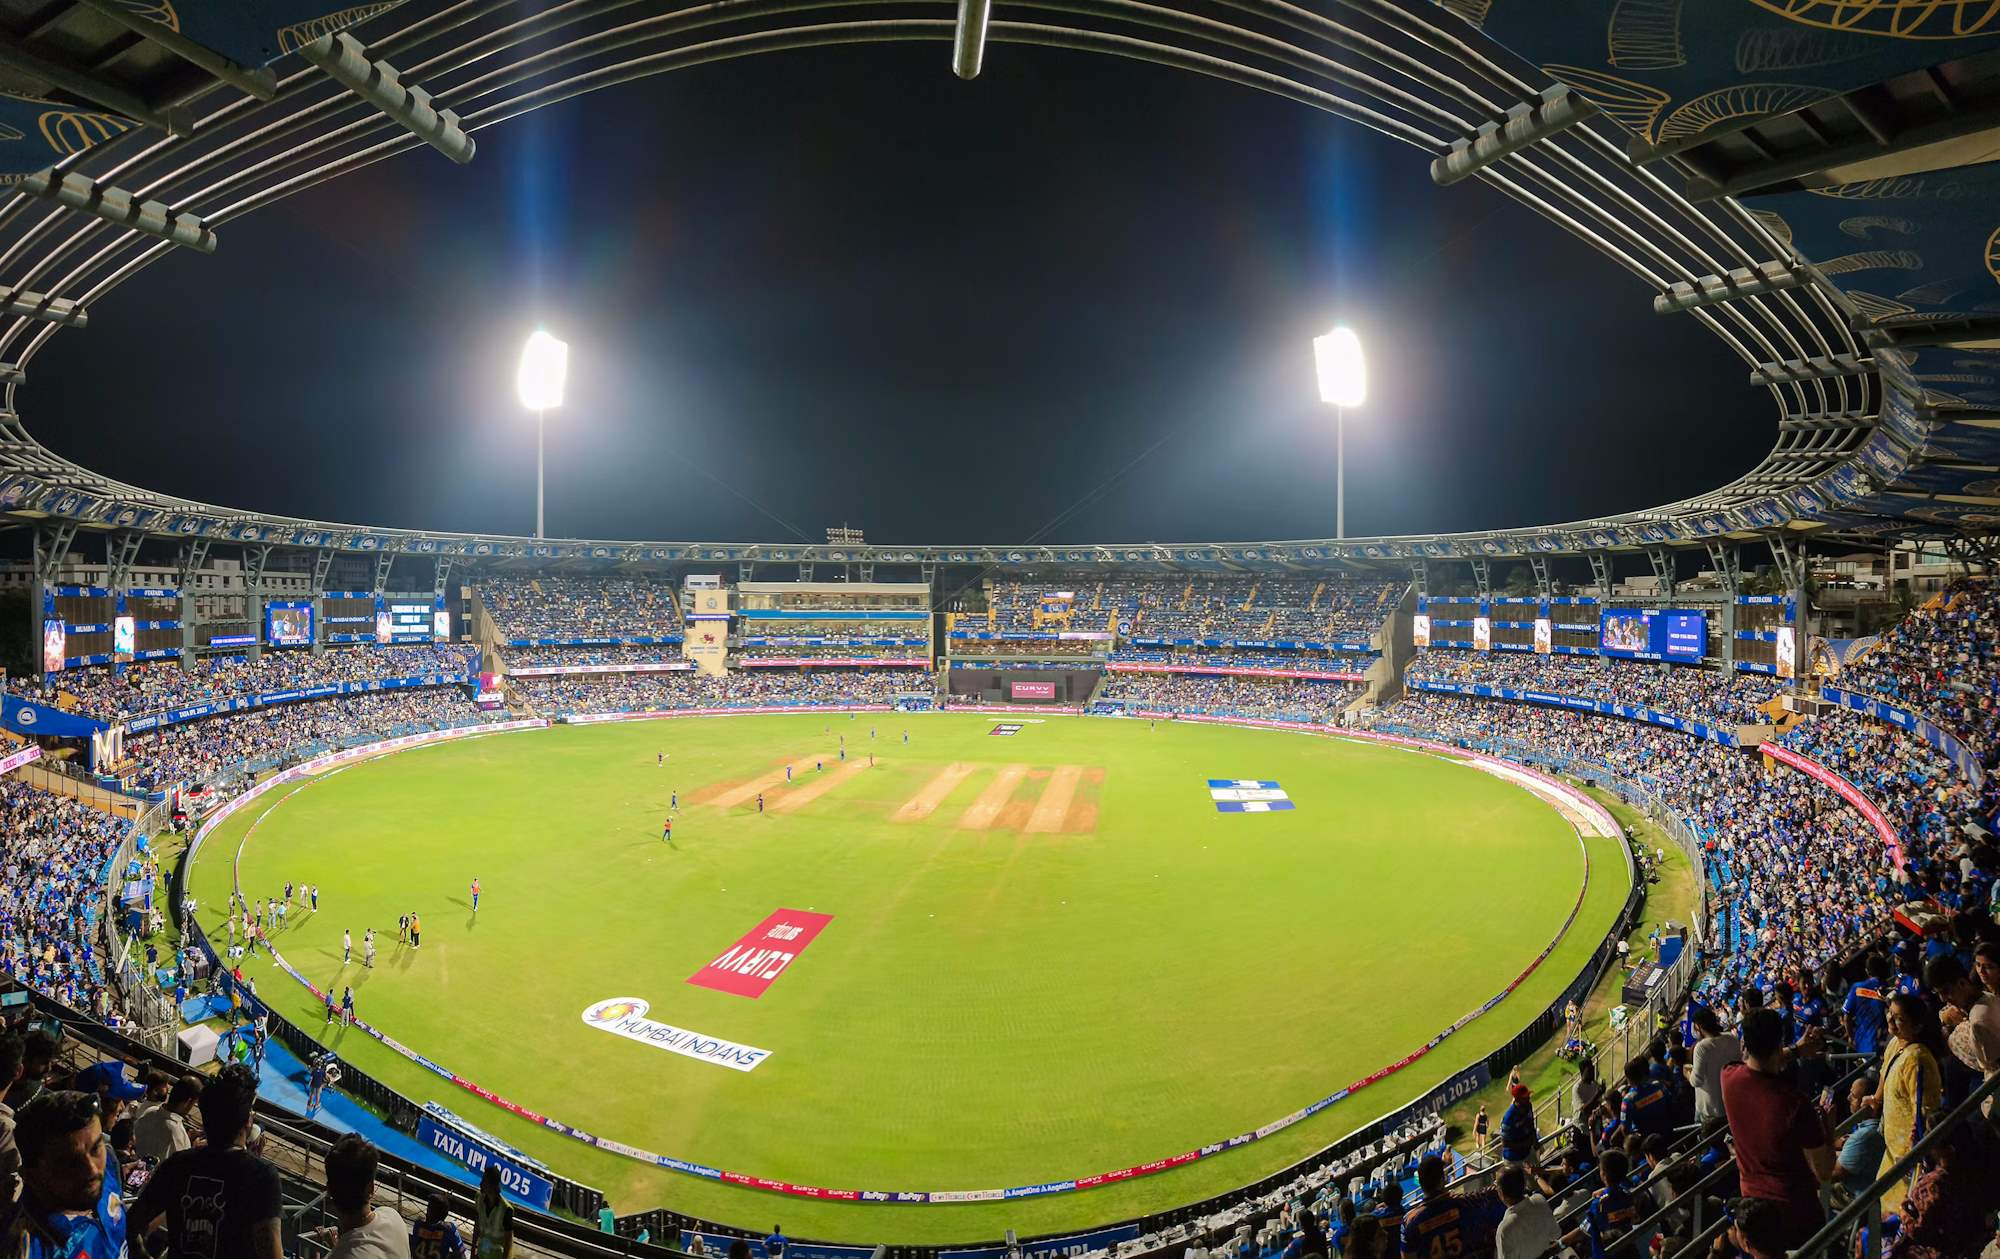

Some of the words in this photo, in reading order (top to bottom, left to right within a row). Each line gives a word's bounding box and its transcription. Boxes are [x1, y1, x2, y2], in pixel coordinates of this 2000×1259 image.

[709, 944, 795, 980] CURVV
[616, 1017, 686, 1049] MUMBAI
[683, 1036, 765, 1065] INDIANS
[1448, 1075, 1478, 1101] 2025
[432, 1129, 464, 1160] TATA
[467, 1150, 488, 1173] IPL
